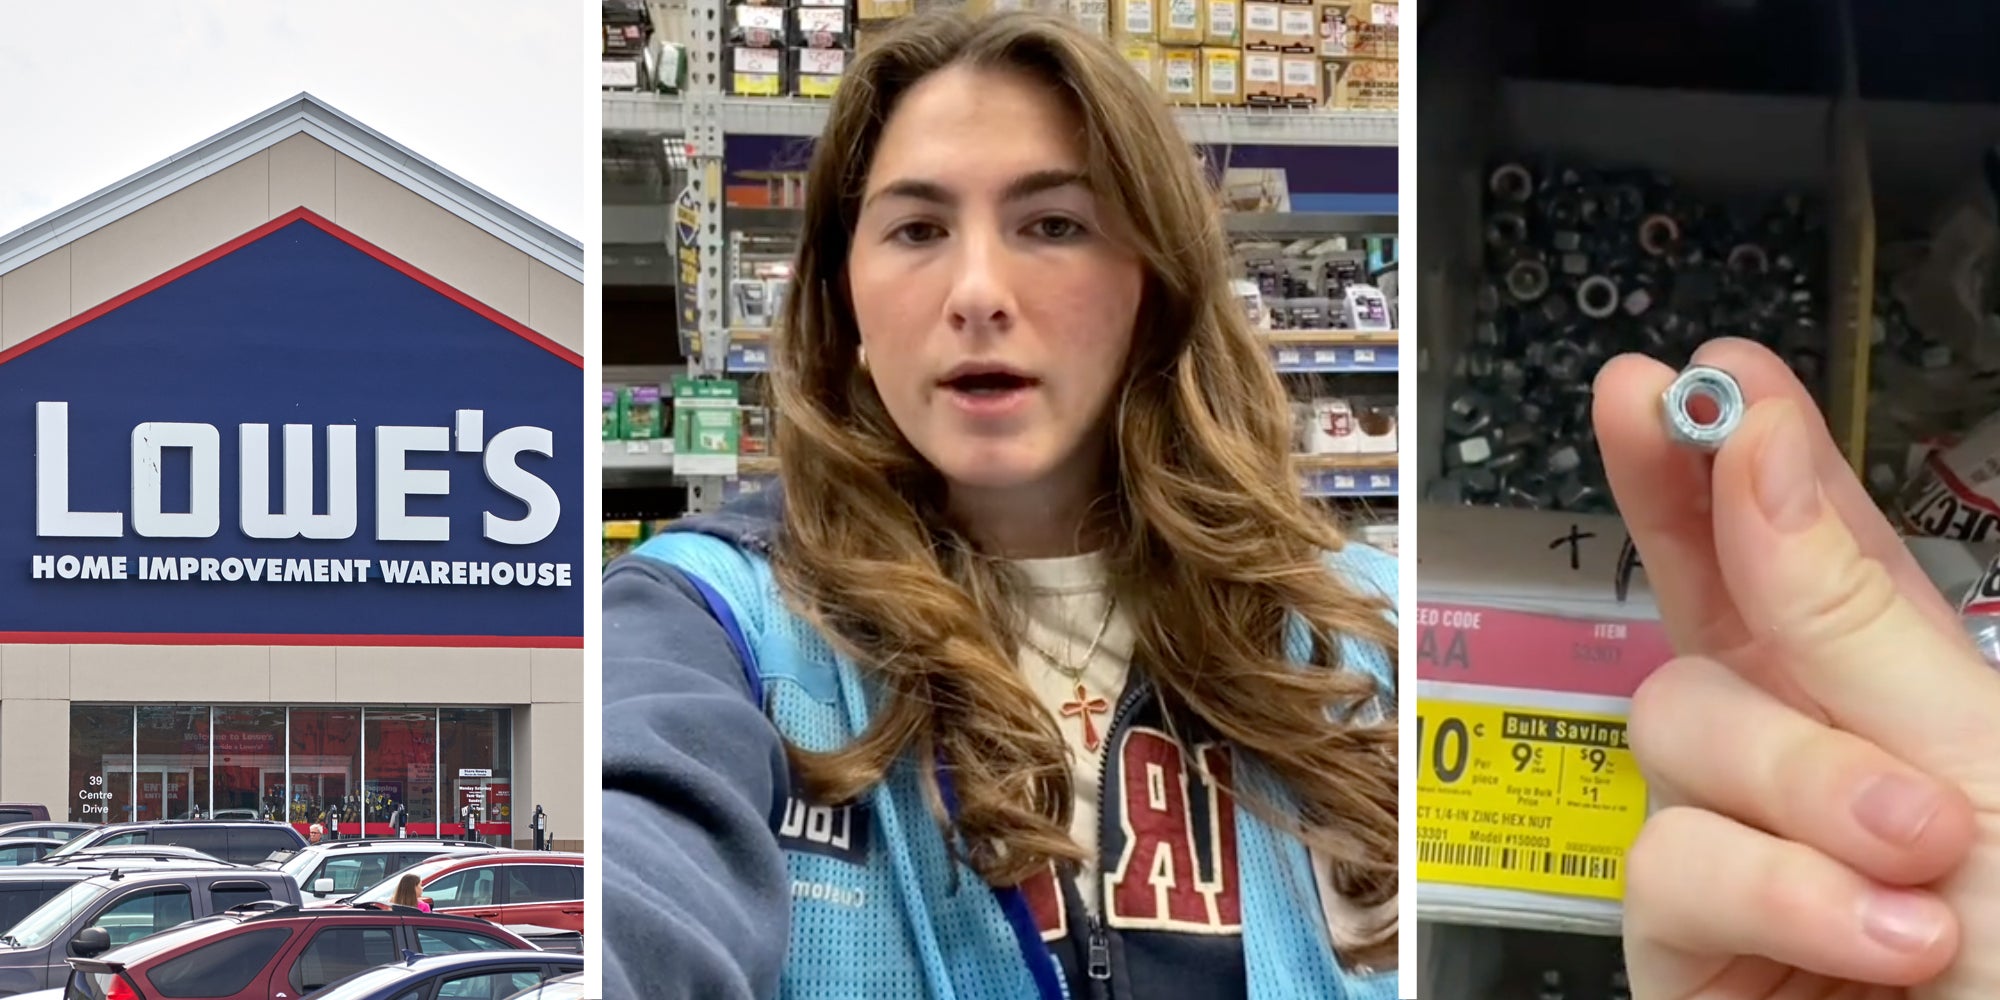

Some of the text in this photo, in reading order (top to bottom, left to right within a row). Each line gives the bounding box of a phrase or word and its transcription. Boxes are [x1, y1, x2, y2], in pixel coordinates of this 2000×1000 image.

[35, 401, 561, 545] LOWE'S
[32, 554, 573, 587] HOME IMPROVEMENT WAREHOUSE
[1443, 609, 1482, 630] CODE
[1593, 623, 1627, 639] ITEM
[1506, 716, 1549, 738] Bulk
[1555, 720, 1629, 747] Savings
[1473, 758, 1492, 769] Per
[89, 775, 103, 786] 39
[1472, 773, 1499, 785] piece
[79, 789, 113, 800] Centre
[1517, 795, 1539, 807] Price
[1533, 787, 1553, 798] Bulk
[1581, 786, 1598, 803] $1
[82, 803, 109, 814] Drive
[1435, 807, 1470, 822] 1/4-IN
[1472, 810, 1500, 825] ZINC
[1501, 812, 1526, 827] HEX
[1528, 815, 1553, 830] NUT
[1469, 829, 1503, 845] Model
